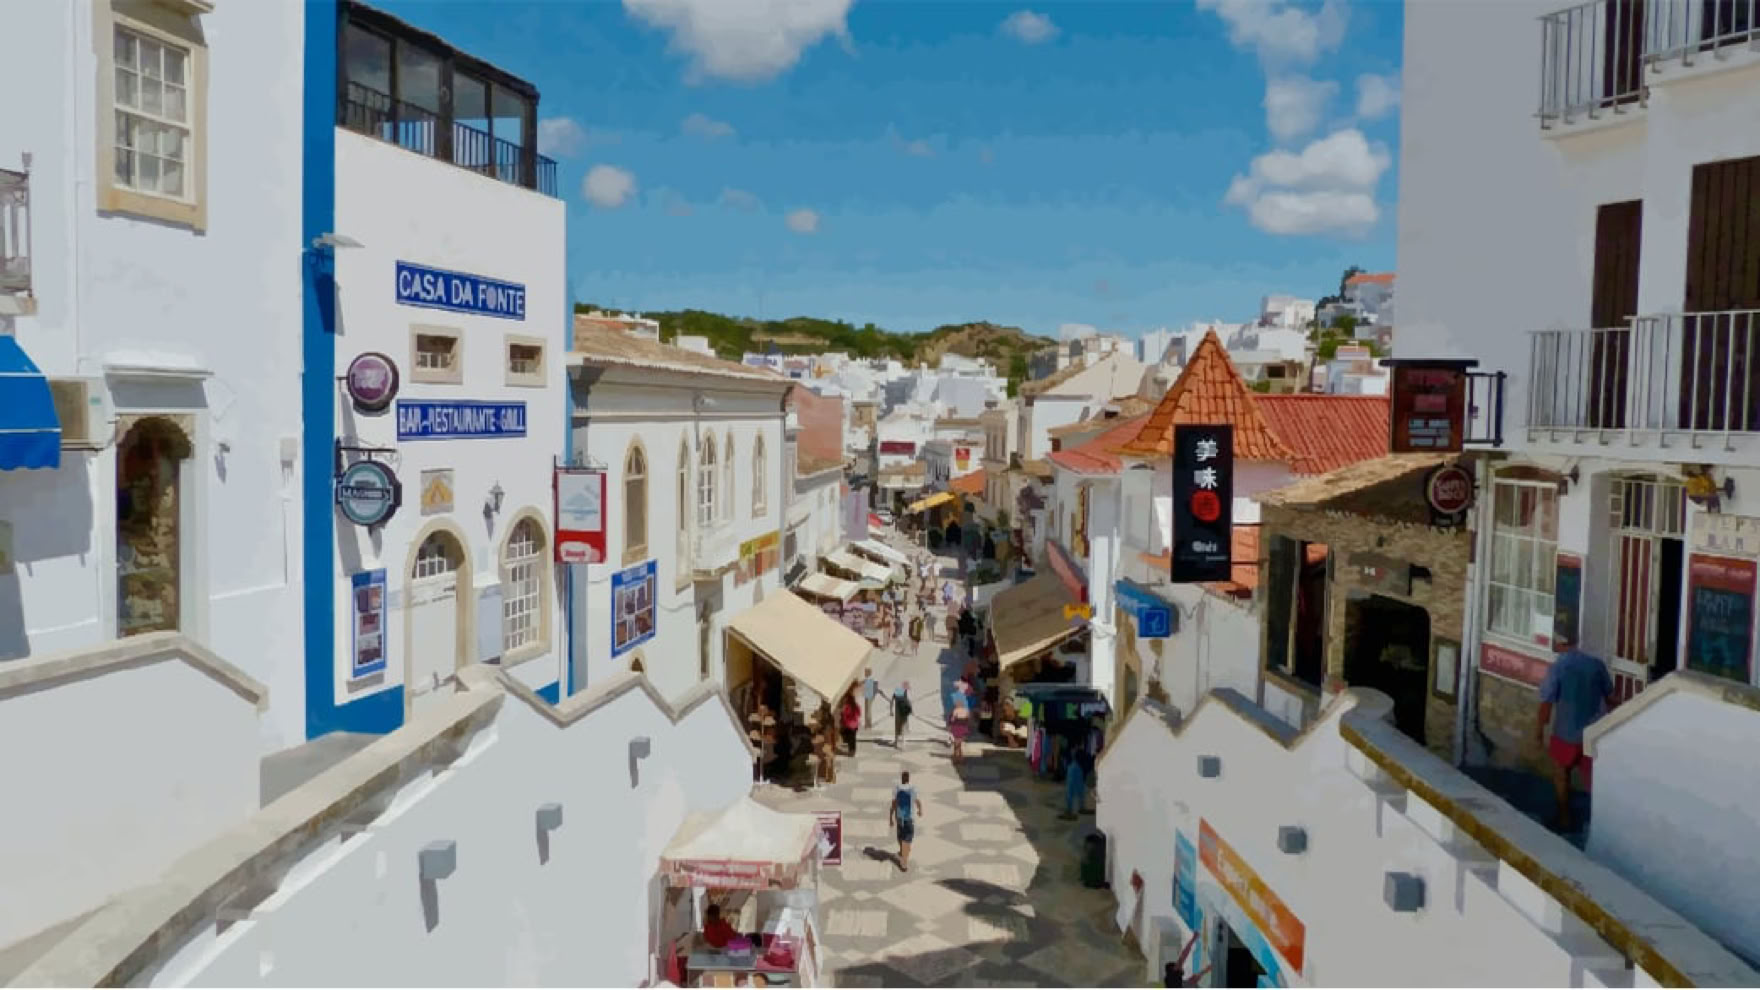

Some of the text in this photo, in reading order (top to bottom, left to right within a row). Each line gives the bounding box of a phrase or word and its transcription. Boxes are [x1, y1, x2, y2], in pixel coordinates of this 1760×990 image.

[399, 269, 525, 315] CASA DA FONTE
